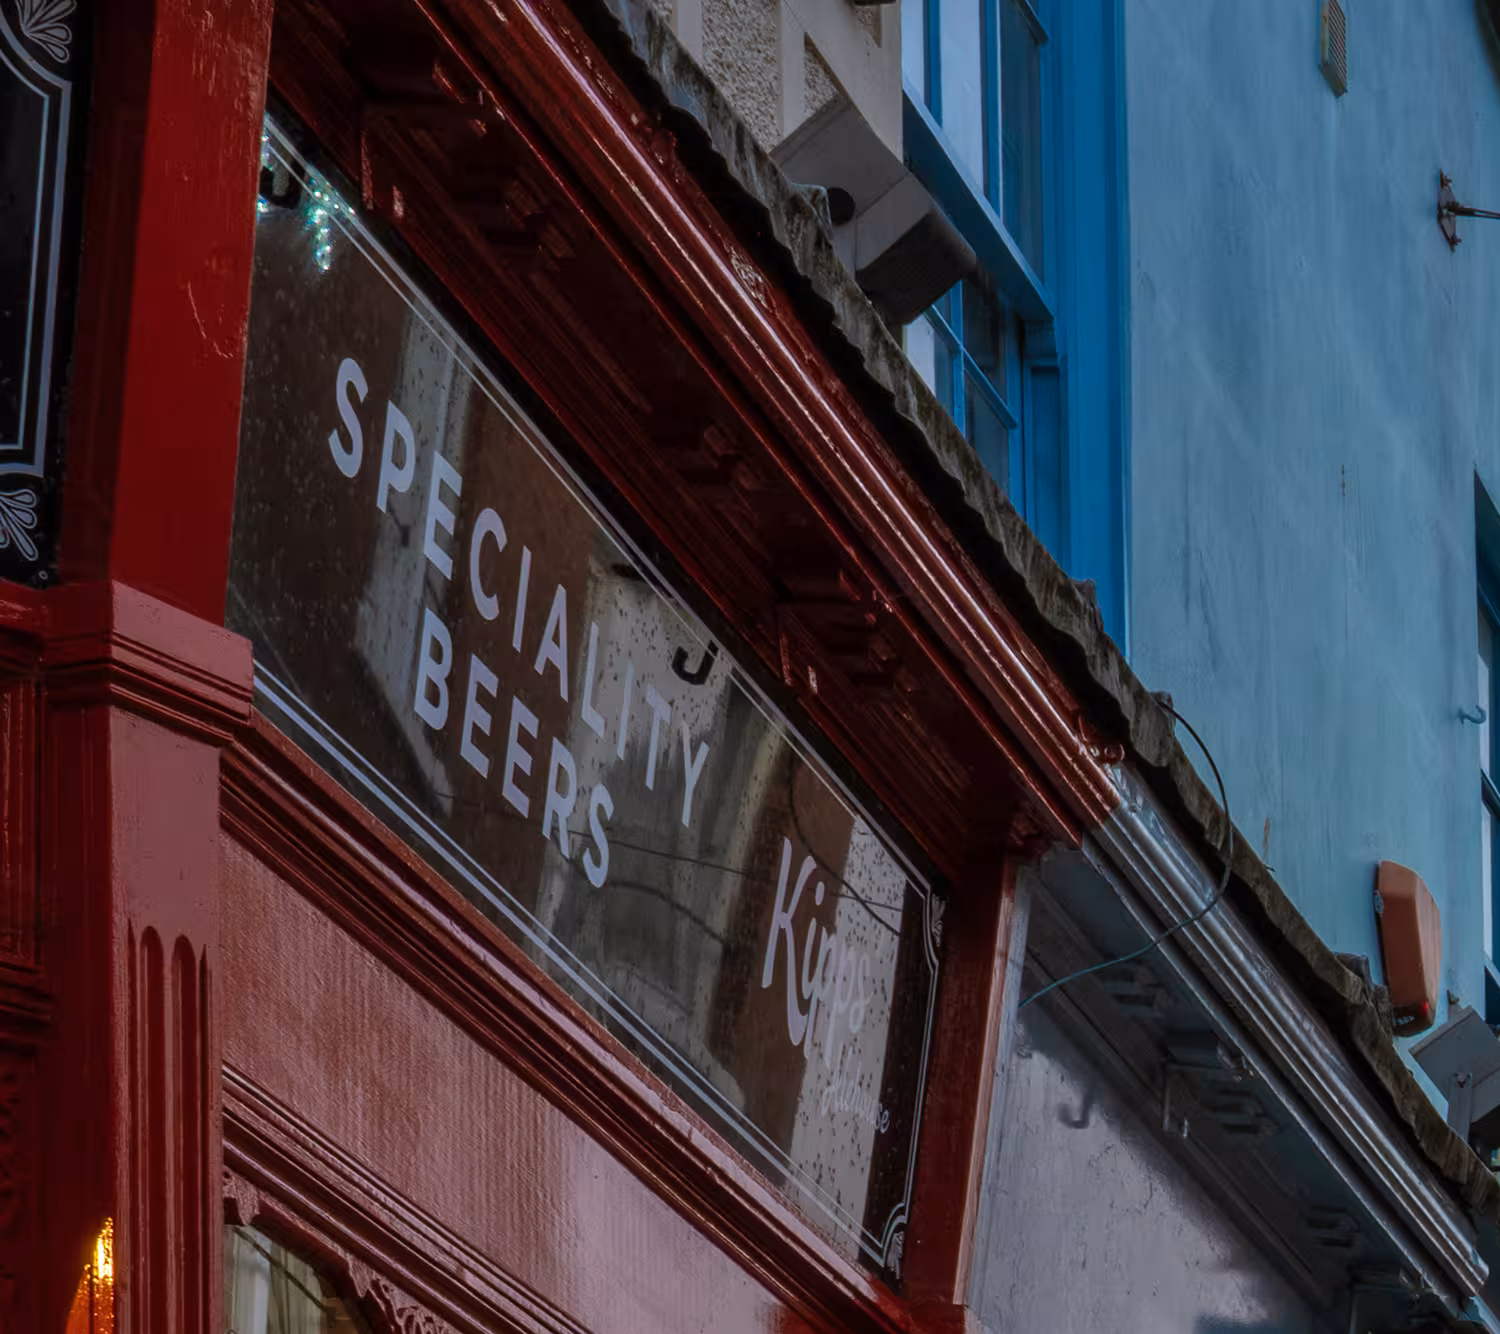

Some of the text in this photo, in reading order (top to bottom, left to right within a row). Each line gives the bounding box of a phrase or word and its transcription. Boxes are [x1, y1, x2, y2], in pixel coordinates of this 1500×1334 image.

[328, 356, 710, 825] SPECIALITY
[412, 605, 616, 889] BEERS
[761, 837, 874, 1069] Kipps
